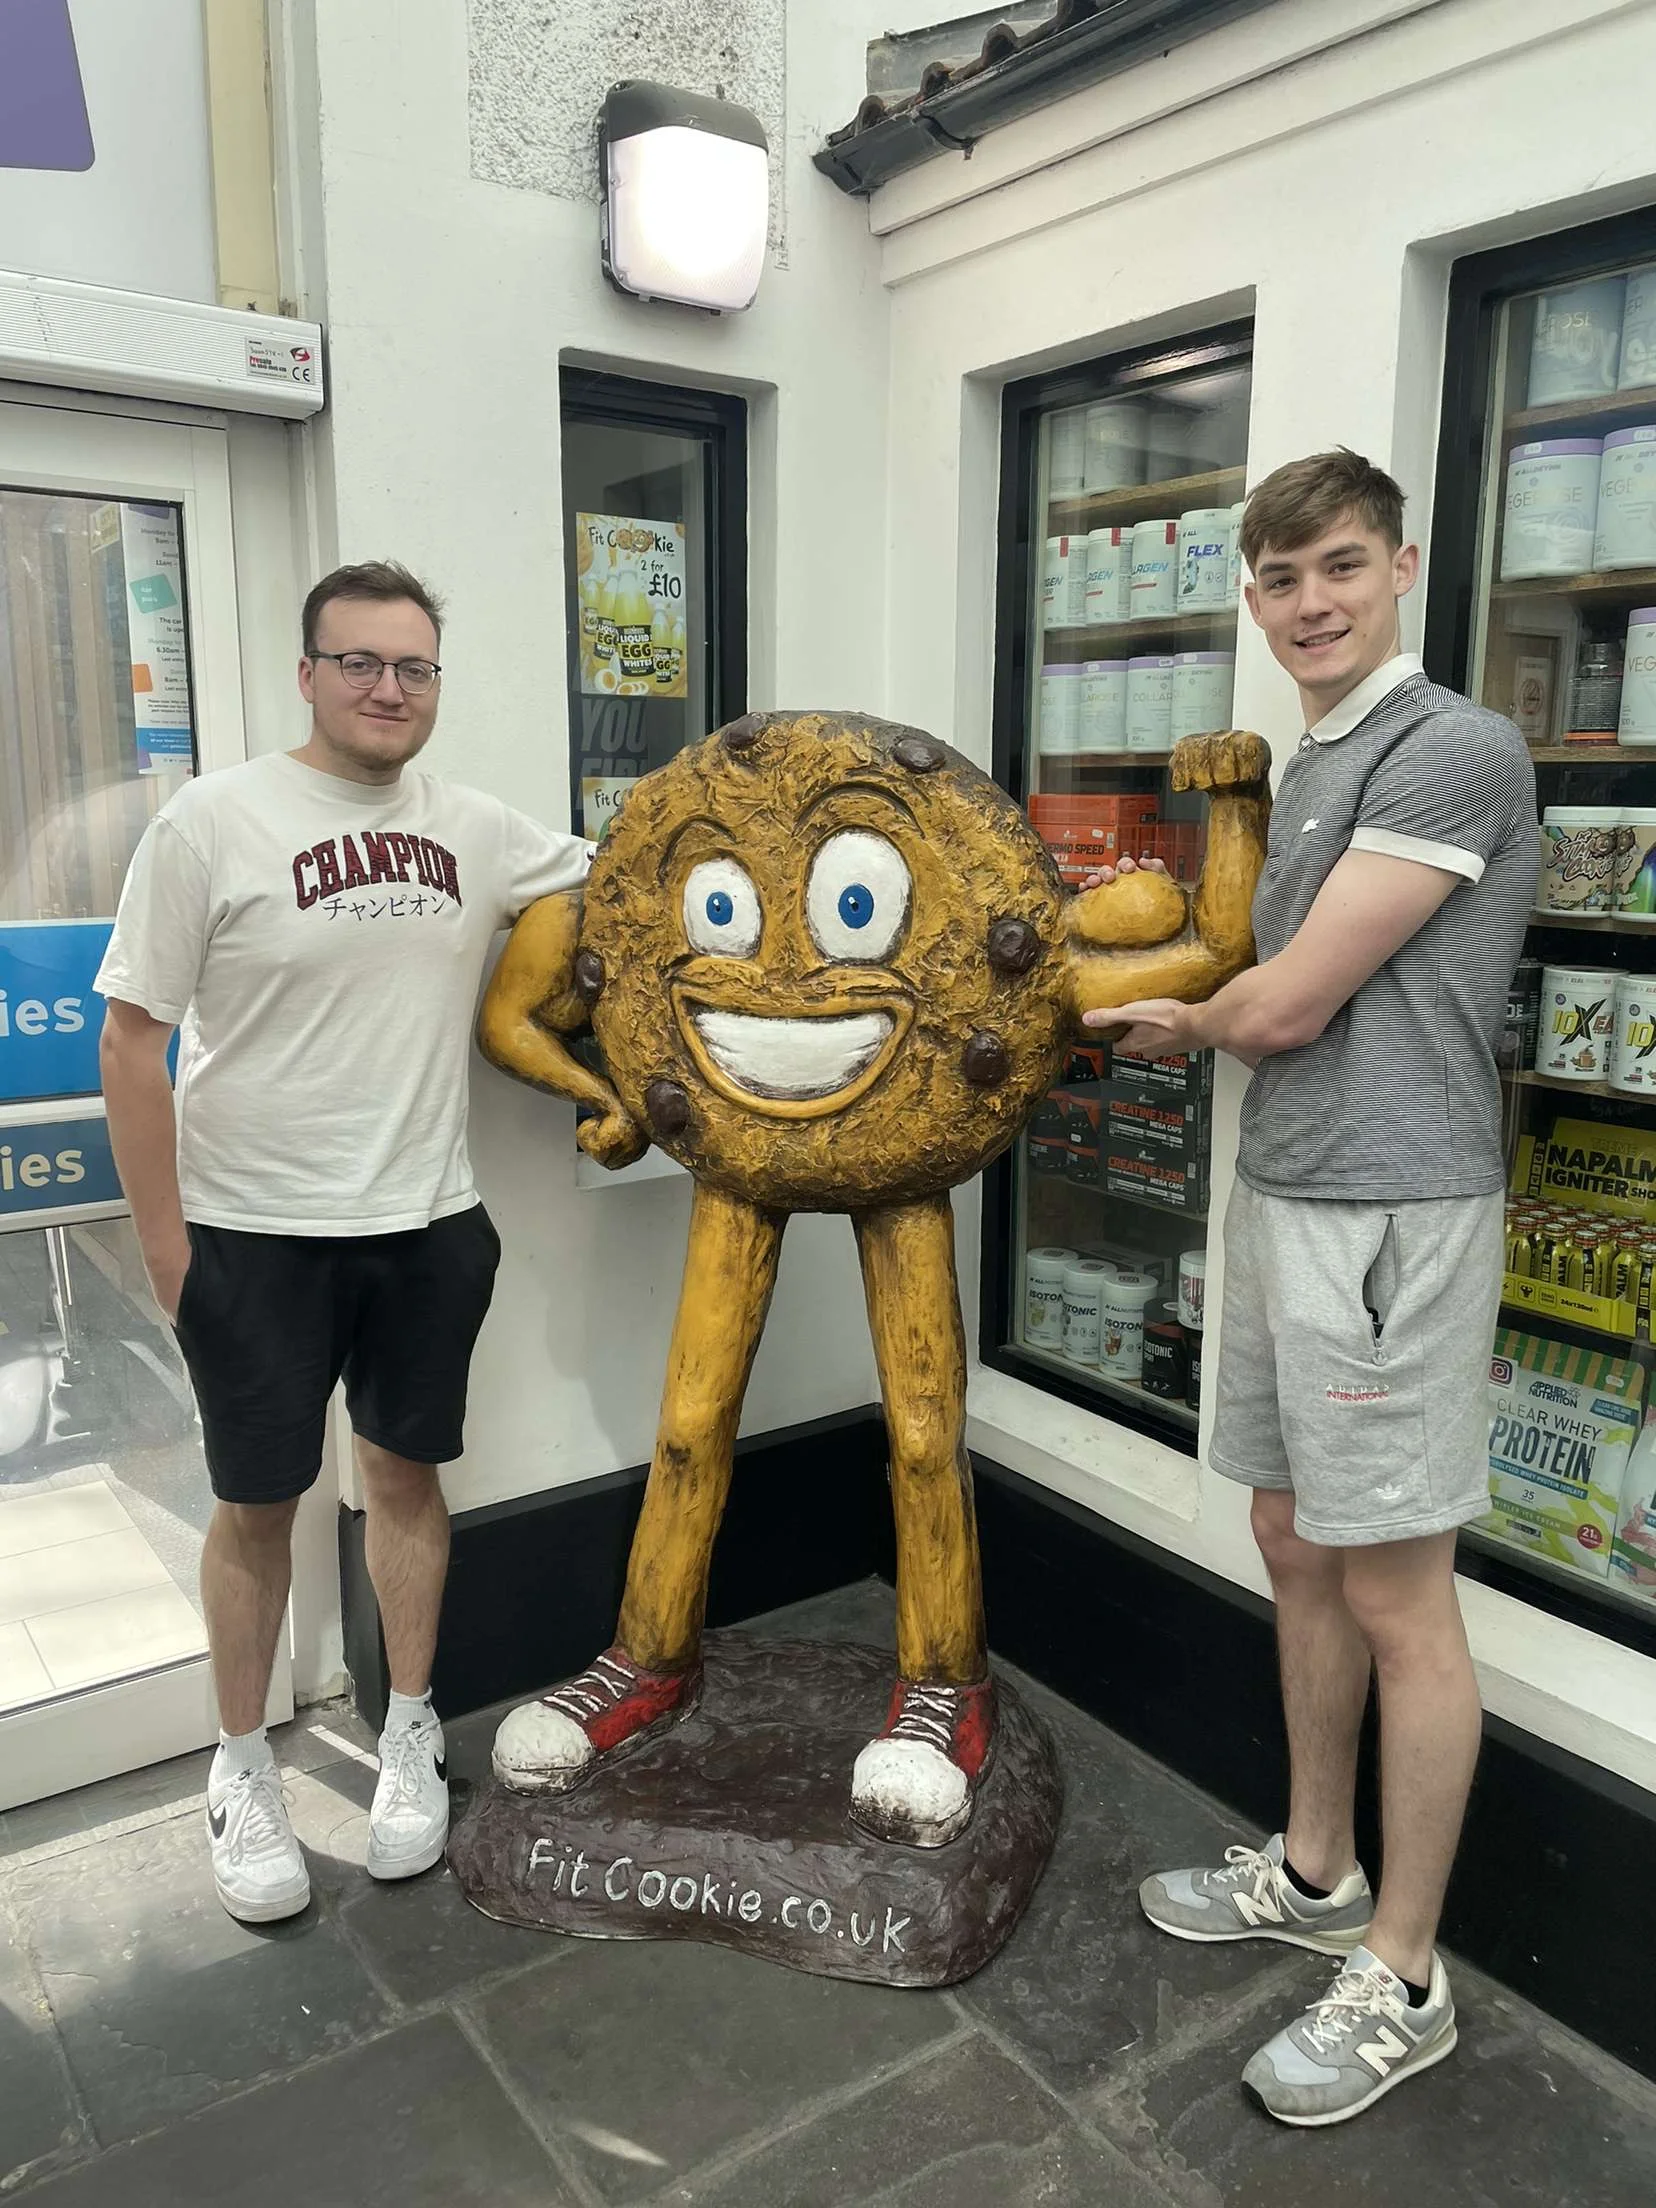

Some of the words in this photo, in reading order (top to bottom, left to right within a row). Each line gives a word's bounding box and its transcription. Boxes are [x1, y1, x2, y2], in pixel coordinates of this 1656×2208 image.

[588, 526, 604, 546] Fit
[1187, 544, 1224, 558] FLEX
[640, 559, 647, 571] 2
[651, 560, 664, 572] for
[648, 573, 682, 599] £10
[620, 634, 650, 643] LIQUID
[621, 644, 652, 658] EGG
[594, 788, 610, 809] Fit
[1074, 843, 1105, 856] SPEED
[292, 831, 463, 911] CHAMPION
[323, 893, 446, 922] チャンピオン
[1170, 1066, 1186, 1076] CAPS
[1109, 1101, 1158, 1120] CREATINE
[1167, 1124, 1183, 1134] CAPS
[1108, 1156, 1158, 1178] CREATINE
[1168, 1182, 1185, 1192] CAPS
[1545, 1167, 1629, 1199] IGNITER
[1529, 1387, 1578, 1409] NUTRITION
[1530, 1380, 1568, 1397] APPLIED
[1497, 1398, 1548, 1425] CLEAR
[1554, 1414, 1603, 1441] WHEY
[1489, 1415, 1597, 1484] PROTEIN
[1522, 1489, 1535, 1500] 35
[528, 1837, 589, 1898] Fit
